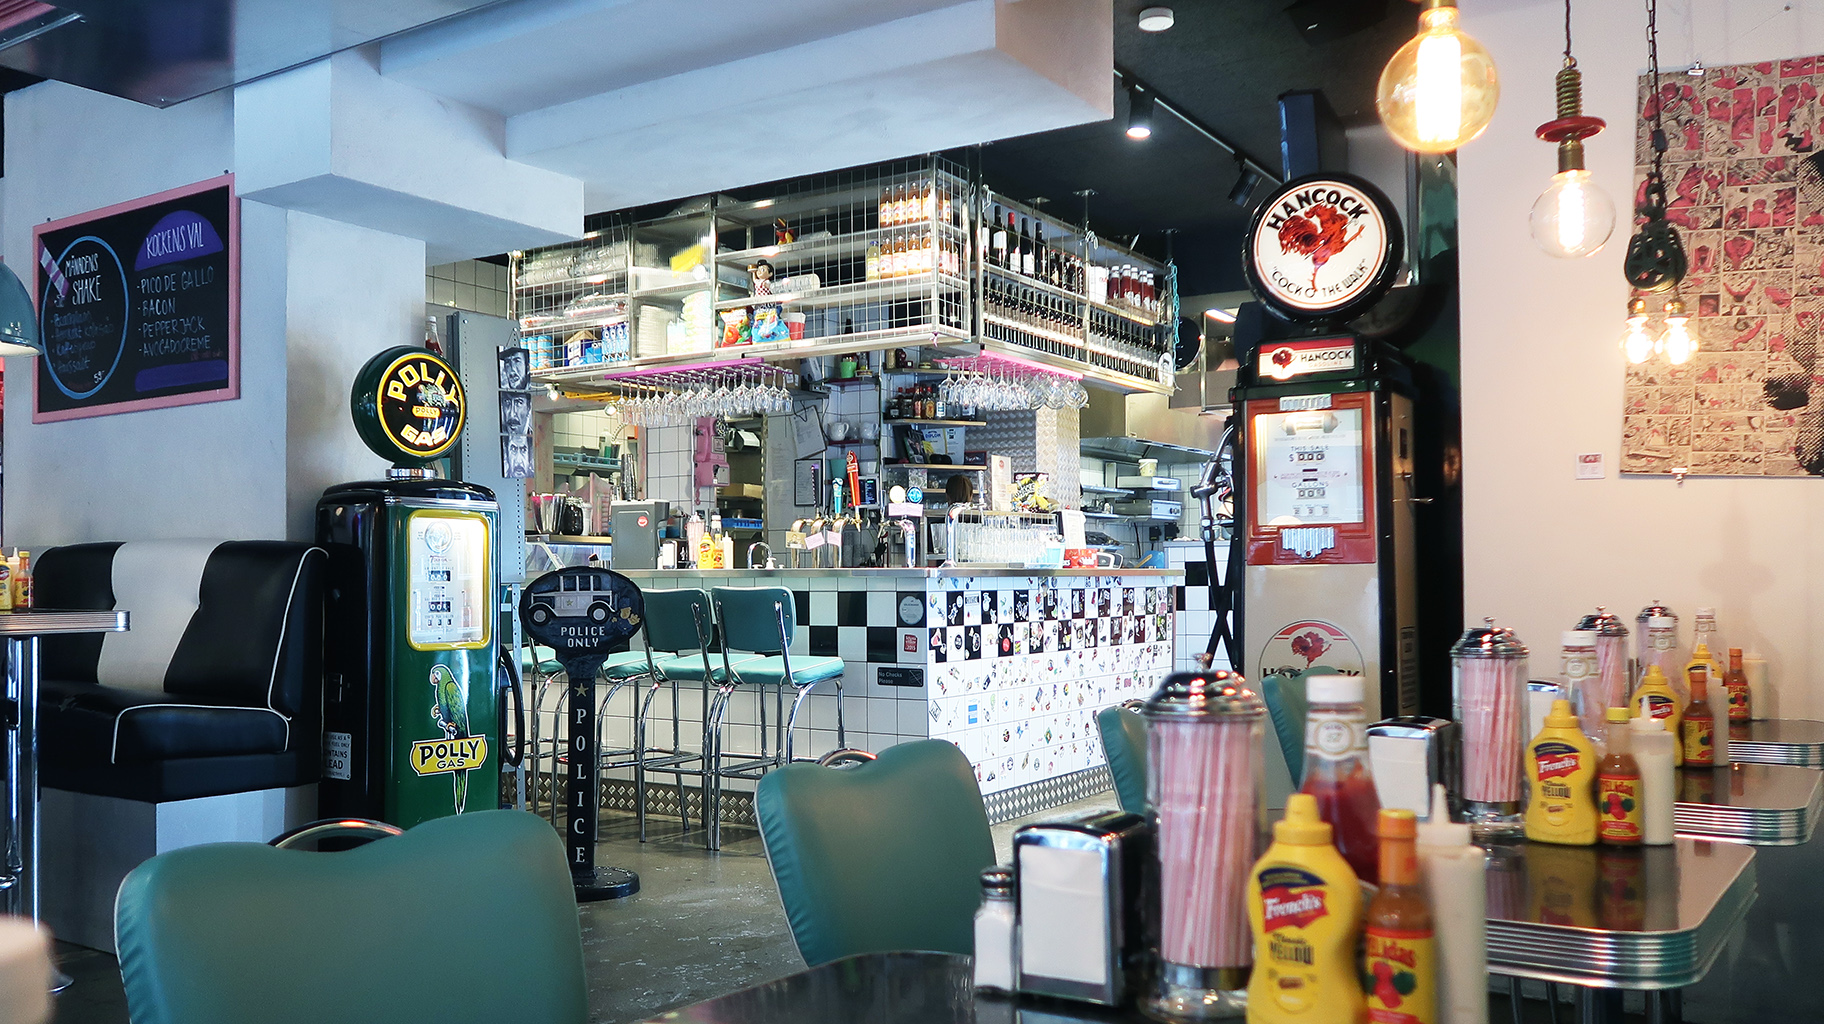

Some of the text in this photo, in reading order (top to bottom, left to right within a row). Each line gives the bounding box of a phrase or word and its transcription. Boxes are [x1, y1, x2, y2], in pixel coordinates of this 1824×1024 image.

[1266, 188, 1370, 230] HANCOCK
[145, 222, 204, 259] KOCKENS VAL
[72, 275, 102, 305] SHAKE
[164, 273, 176, 291] DE
[181, 266, 214, 290] GALLO
[1322, 283, 1341, 297] THE
[1300, 350, 1352, 362] HANCOCK
[387, 362, 459, 407] POLLY
[400, 424, 447, 447] GAS
[561, 626, 605, 636] POLICE
[567, 638, 599, 648] ONLY
[419, 740, 480, 766] POLLY
[437, 758, 465, 770] GAS
